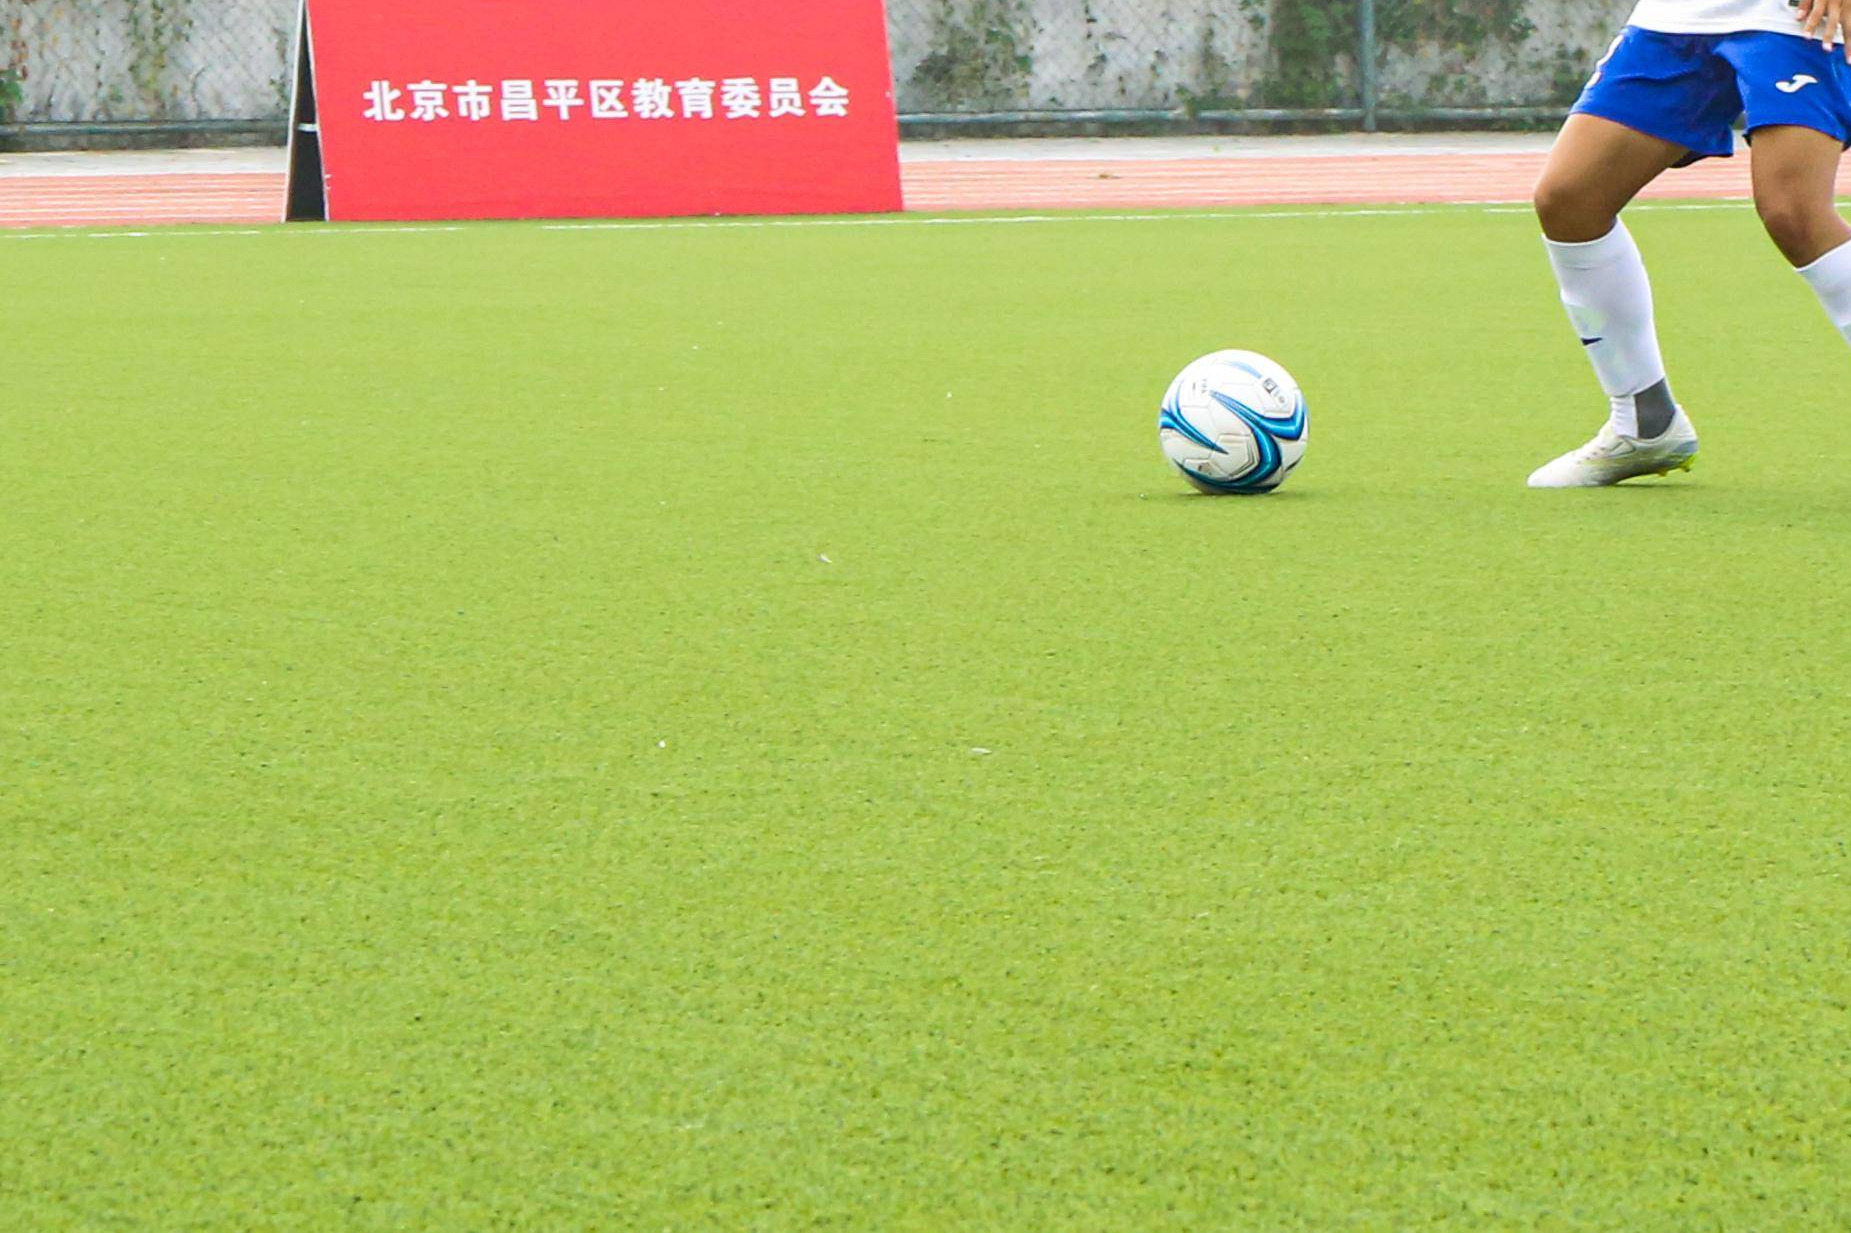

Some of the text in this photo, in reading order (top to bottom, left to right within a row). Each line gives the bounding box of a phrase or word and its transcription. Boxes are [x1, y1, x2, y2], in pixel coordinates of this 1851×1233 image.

[362, 76, 849, 121] 北京市昌平区教育委员会
